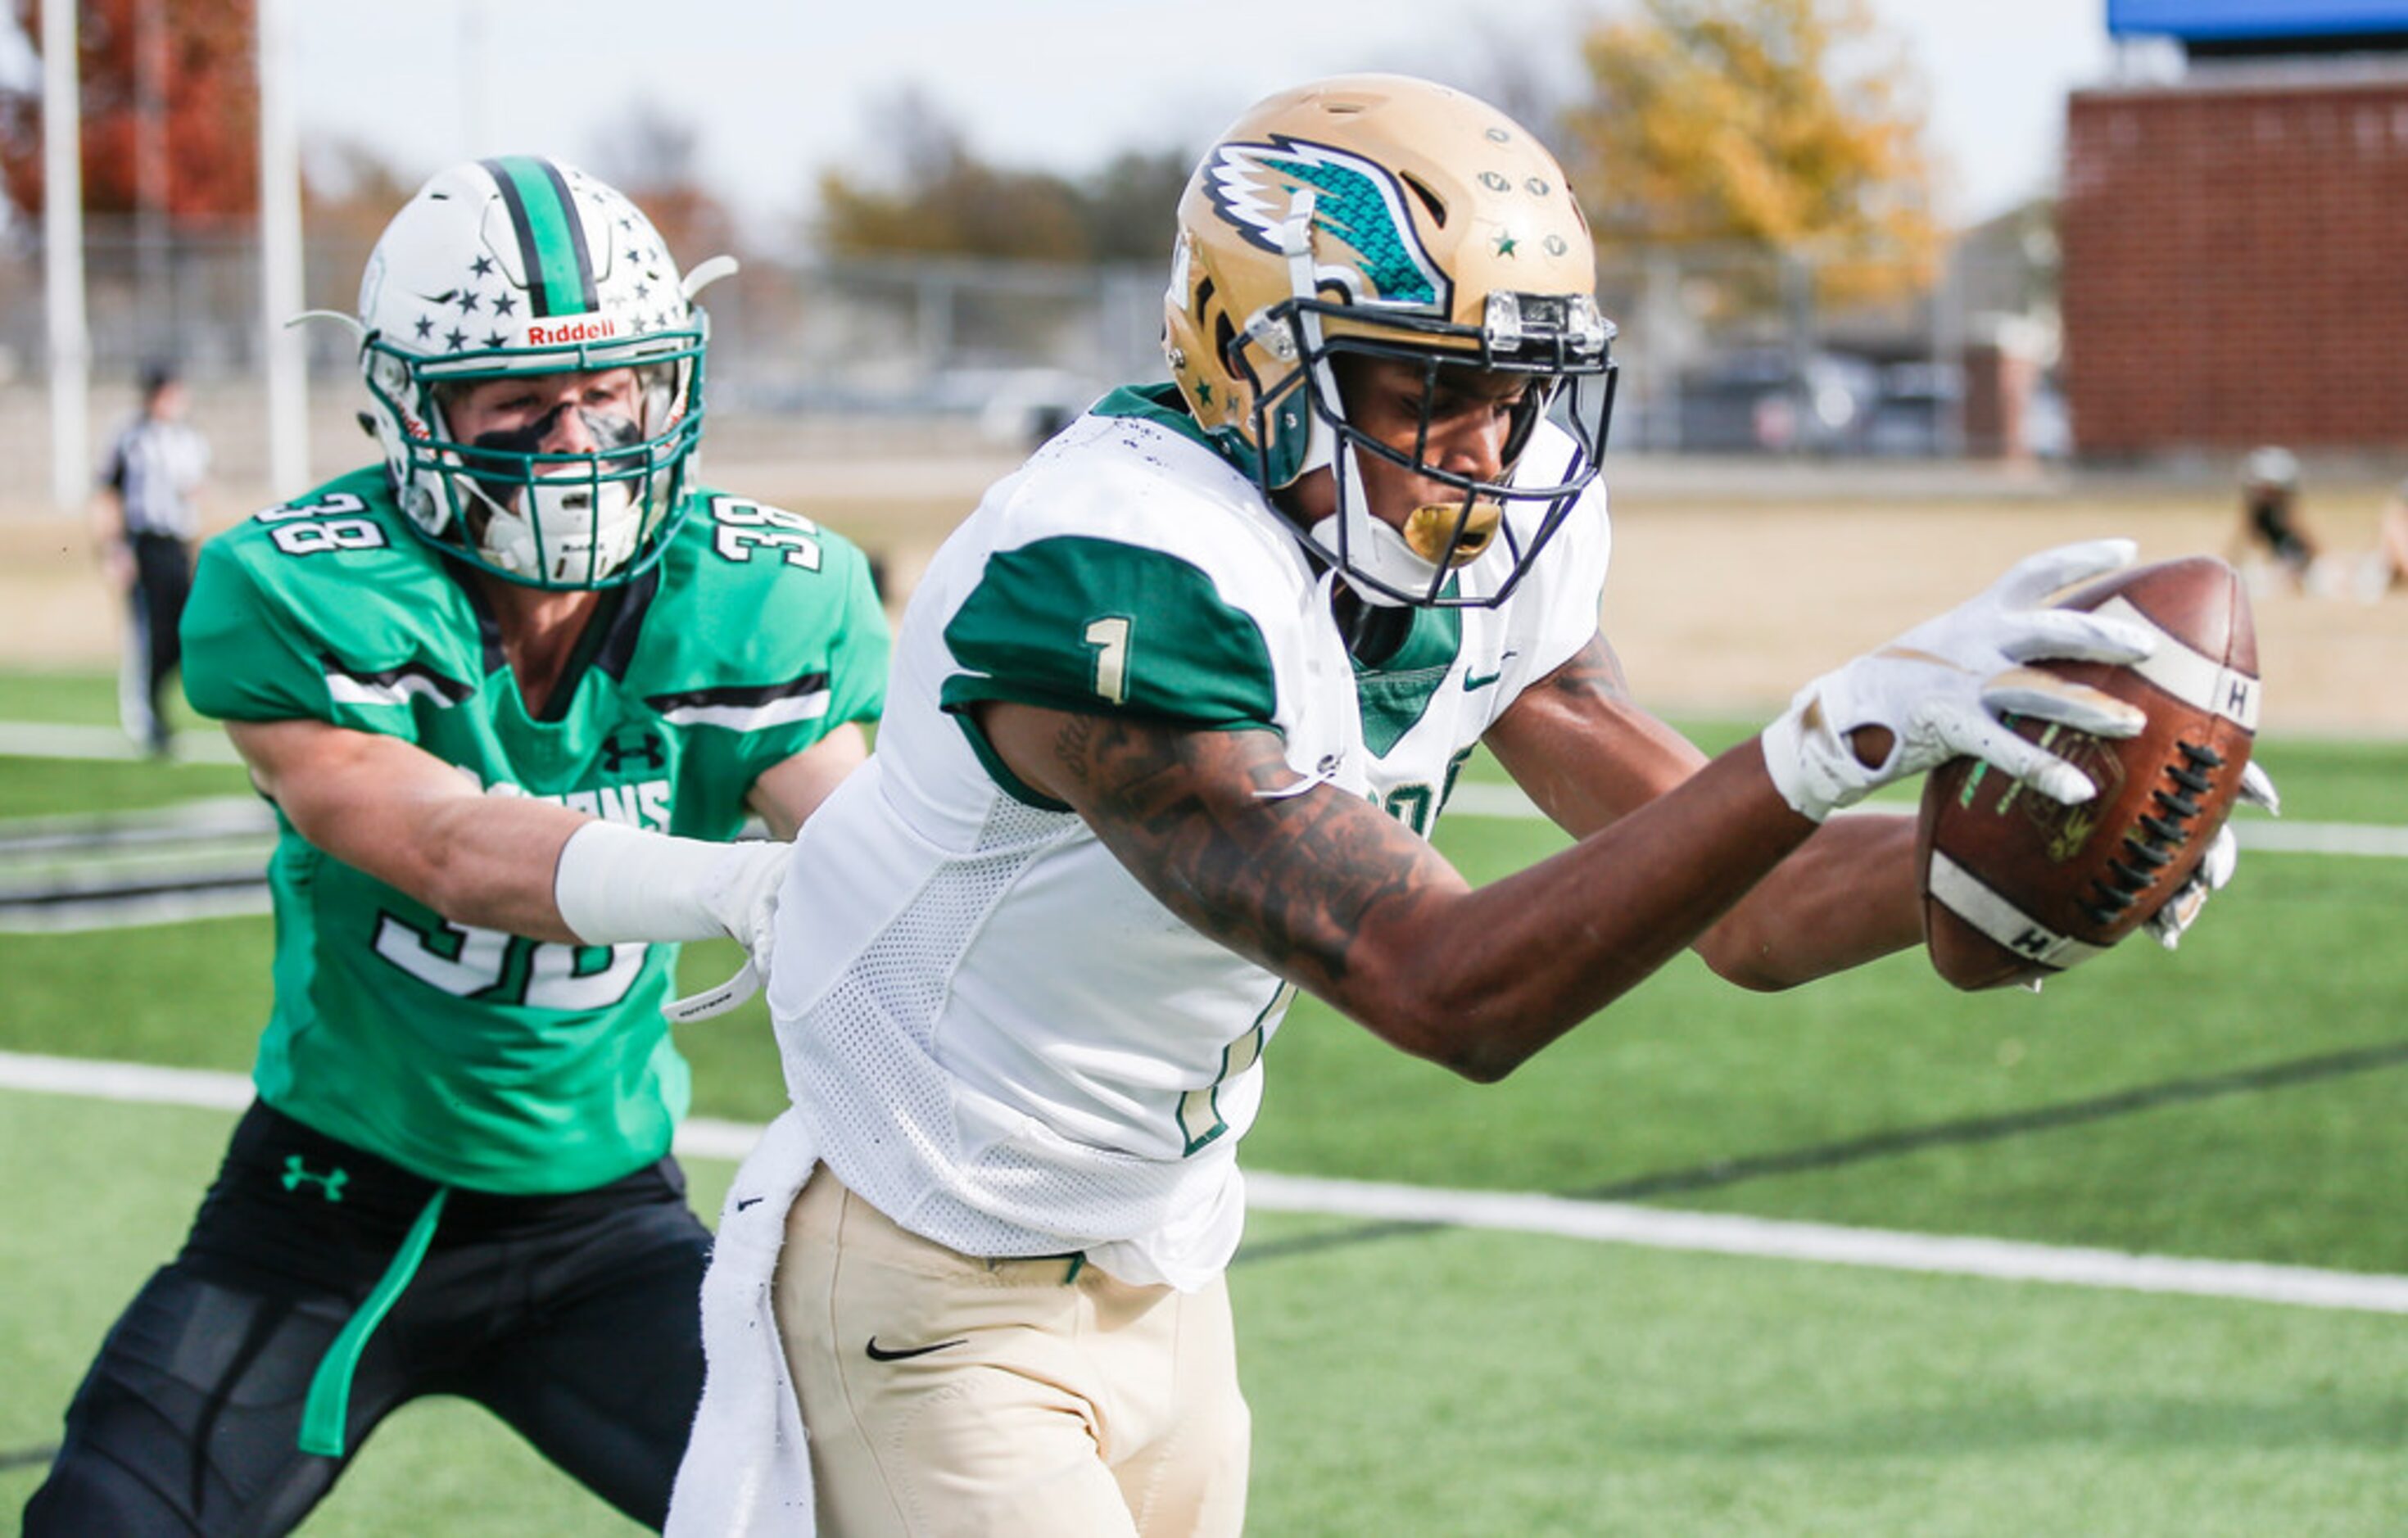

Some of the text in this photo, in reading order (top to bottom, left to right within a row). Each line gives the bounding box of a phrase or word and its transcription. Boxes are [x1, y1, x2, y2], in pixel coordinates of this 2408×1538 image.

[528, 319, 614, 345] Riddell
[254, 493, 390, 556] 38
[708, 494, 822, 573] 38
[1084, 617, 1130, 705] 1
[2228, 680, 2248, 718] H
[2012, 928, 2049, 953] H
